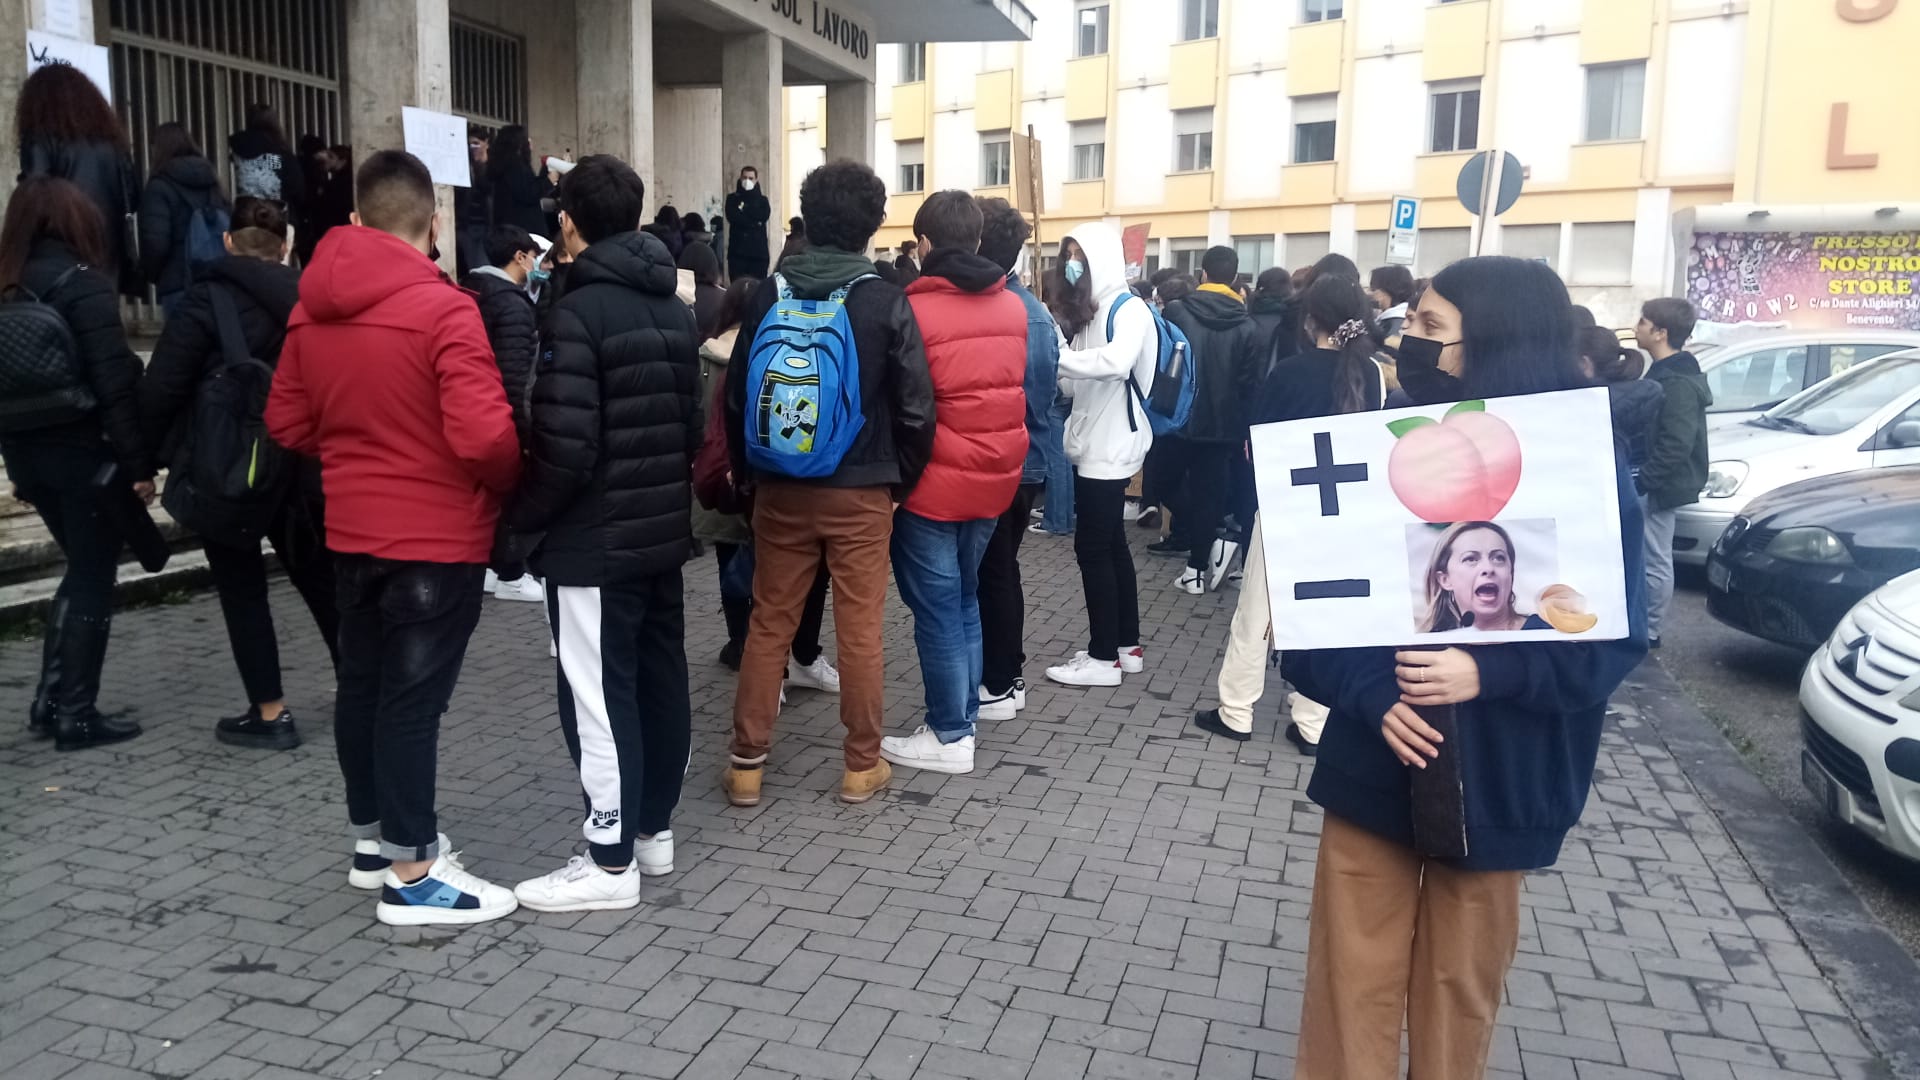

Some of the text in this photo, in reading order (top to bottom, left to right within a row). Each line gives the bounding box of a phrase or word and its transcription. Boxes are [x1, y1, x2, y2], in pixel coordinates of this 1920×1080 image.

[813, 1, 869, 60] LAVORO
[1399, 203, 1412, 225] P
[1812, 235, 1910, 249] PRESSO
[1819, 255, 1920, 272] NOSTRO
[1828, 279, 1912, 295] STORE
[1832, 297, 1859, 309] Dante
[1862, 297, 1903, 311] Alighieri
[1846, 312, 1895, 324] Benevento
